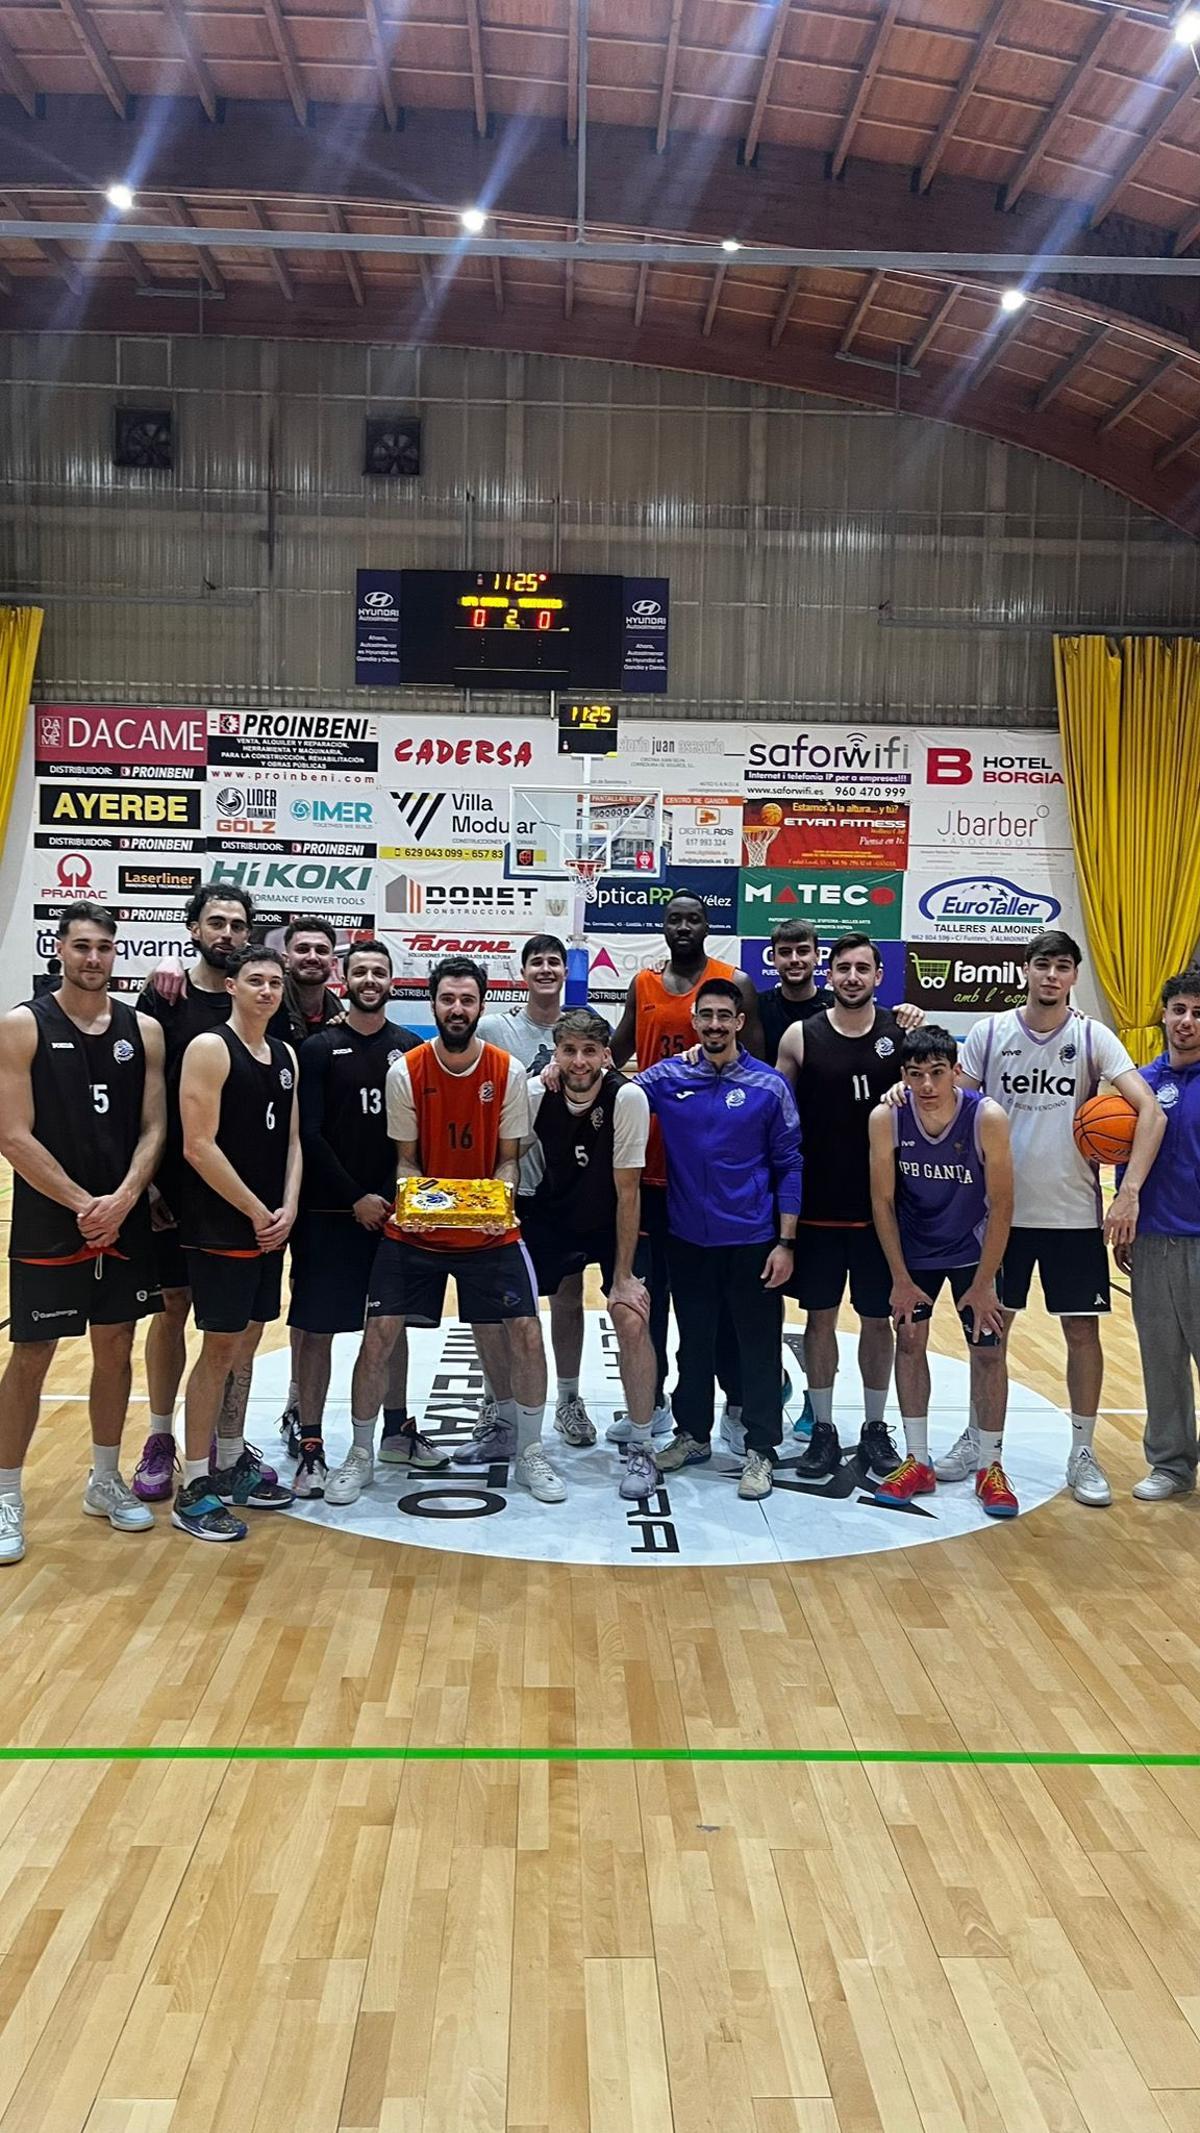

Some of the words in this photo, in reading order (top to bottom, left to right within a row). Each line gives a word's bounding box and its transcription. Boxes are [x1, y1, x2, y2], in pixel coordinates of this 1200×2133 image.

[358, 608, 399, 616] HYUNDAI
[474, 609, 486, 627] 0
[506, 609, 518, 624] 2
[539, 611, 550, 628] 0
[68, 717, 204, 751] DACAME
[242, 714, 369, 740] PROINBENI
[394, 738, 532, 767] CADERSA
[651, 737, 675, 755] juan
[749, 734, 908, 768] saforwifi
[926, 747, 973, 785] B
[983, 756, 1052, 769] HOTEL
[131, 766, 194, 779] PROINBENI
[211, 770, 374, 783] www.proinbeni.com
[749, 771, 781, 780] Internet
[835, 775, 850, 783] per
[983, 771, 1064, 784] BORGIA
[247, 788, 276, 807] LIDER
[747, 786, 824, 796] www.saforwifi.es
[835, 787, 856, 796] 960
[860, 787, 881, 796] 470
[884, 788, 905, 797] 999
[52, 792, 188, 822] AYERBE
[452, 793, 493, 811] Villa
[792, 803, 828, 811] Estamos
[836, 804, 845, 812] la
[247, 808, 276, 819] DIAMANT
[313, 800, 373, 824] IMER
[452, 815, 537, 834] Moduar
[784, 818, 836, 827] ETVAN
[840, 819, 906, 828] FITNESS
[937, 810, 1038, 837] J.barber
[131, 838, 194, 851] PROINBENI
[302, 843, 364, 856] PROINBENI
[405, 848, 422, 857] 629
[424, 848, 442, 857] 043
[445, 849, 462, 858] 099
[472, 849, 489, 858] 657
[491, 850, 503, 858] 83
[125, 872, 194, 885] Laserliner
[41, 889, 107, 899] PRAMAC
[252, 893, 299, 903] ORMANCE
[302, 895, 334, 904] POWER
[337, 897, 365, 906] TOOLS
[426, 886, 538, 906] DONET
[942, 896, 1039, 916] EuroTaller
[130, 909, 188, 922] PROINBE
[934, 924, 986, 933] TALLERES
[990, 925, 1045, 934] ALMOINES
[114, 939, 197, 960] qvarna
[954, 960, 1027, 989] family
[390, 988, 431, 997] DISTRIBUI
[485, 990, 530, 1002] OINBENI
[587, 991, 628, 1000] DISTRIBUI
[953, 988, 981, 1003] amb
[852, 1074, 871, 1100] 11
[1001, 1068, 1076, 1097] teika
[92, 1084, 110, 1114] 5
[360, 1087, 382, 1115] 13
[266, 1101, 275, 1130] 6
[448, 1122, 474, 1149] 16
[575, 1145, 589, 1167] 5
